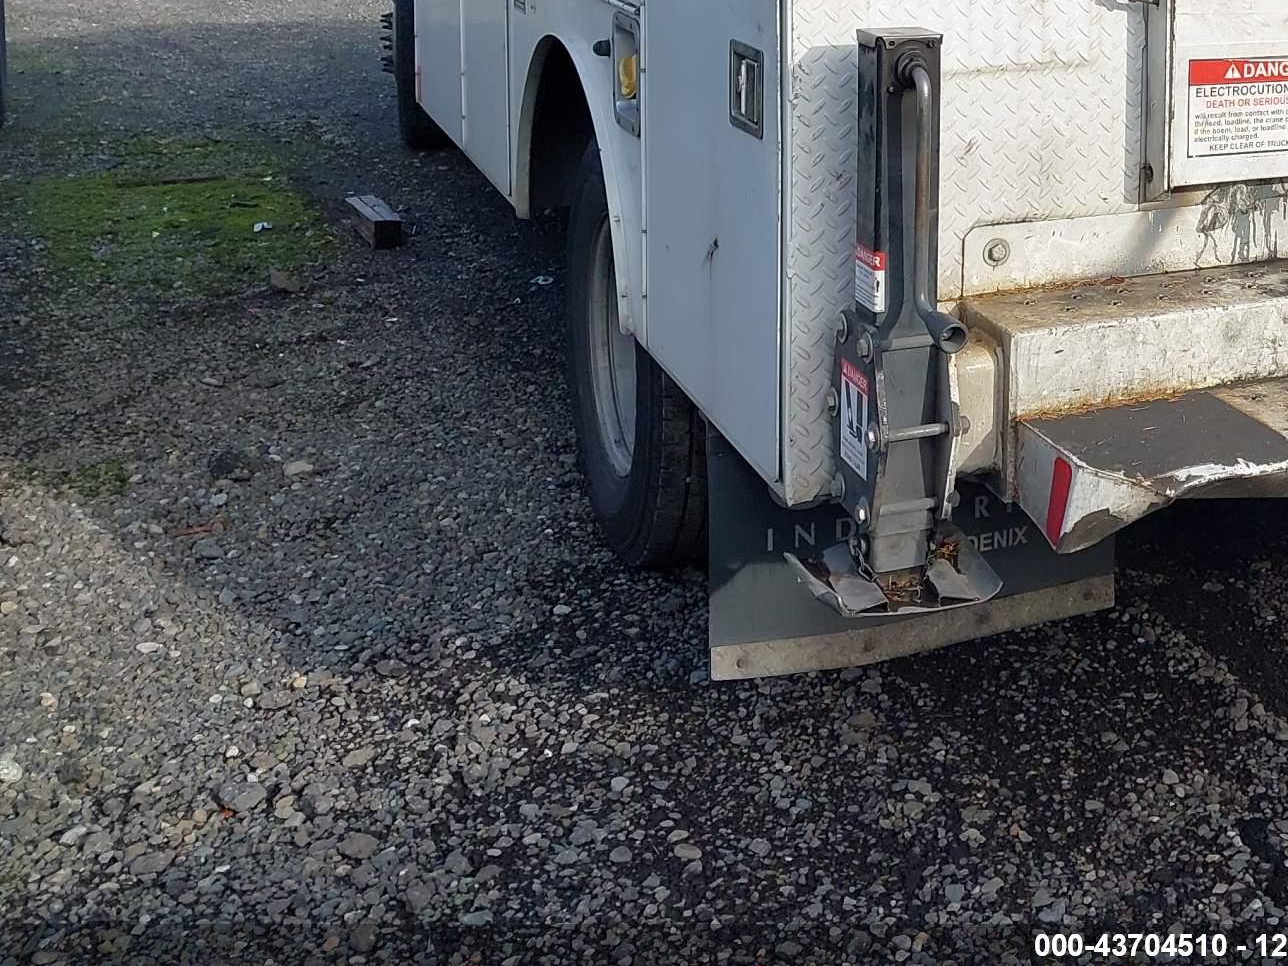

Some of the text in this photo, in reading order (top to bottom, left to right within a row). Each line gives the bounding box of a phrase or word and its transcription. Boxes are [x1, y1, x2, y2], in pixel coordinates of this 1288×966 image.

[1206, 99, 1235, 109] DEATH
[1237, 98, 1251, 107] OR
[1209, 143, 1228, 151] KEEP
[1230, 141, 1254, 150] CLEAR
